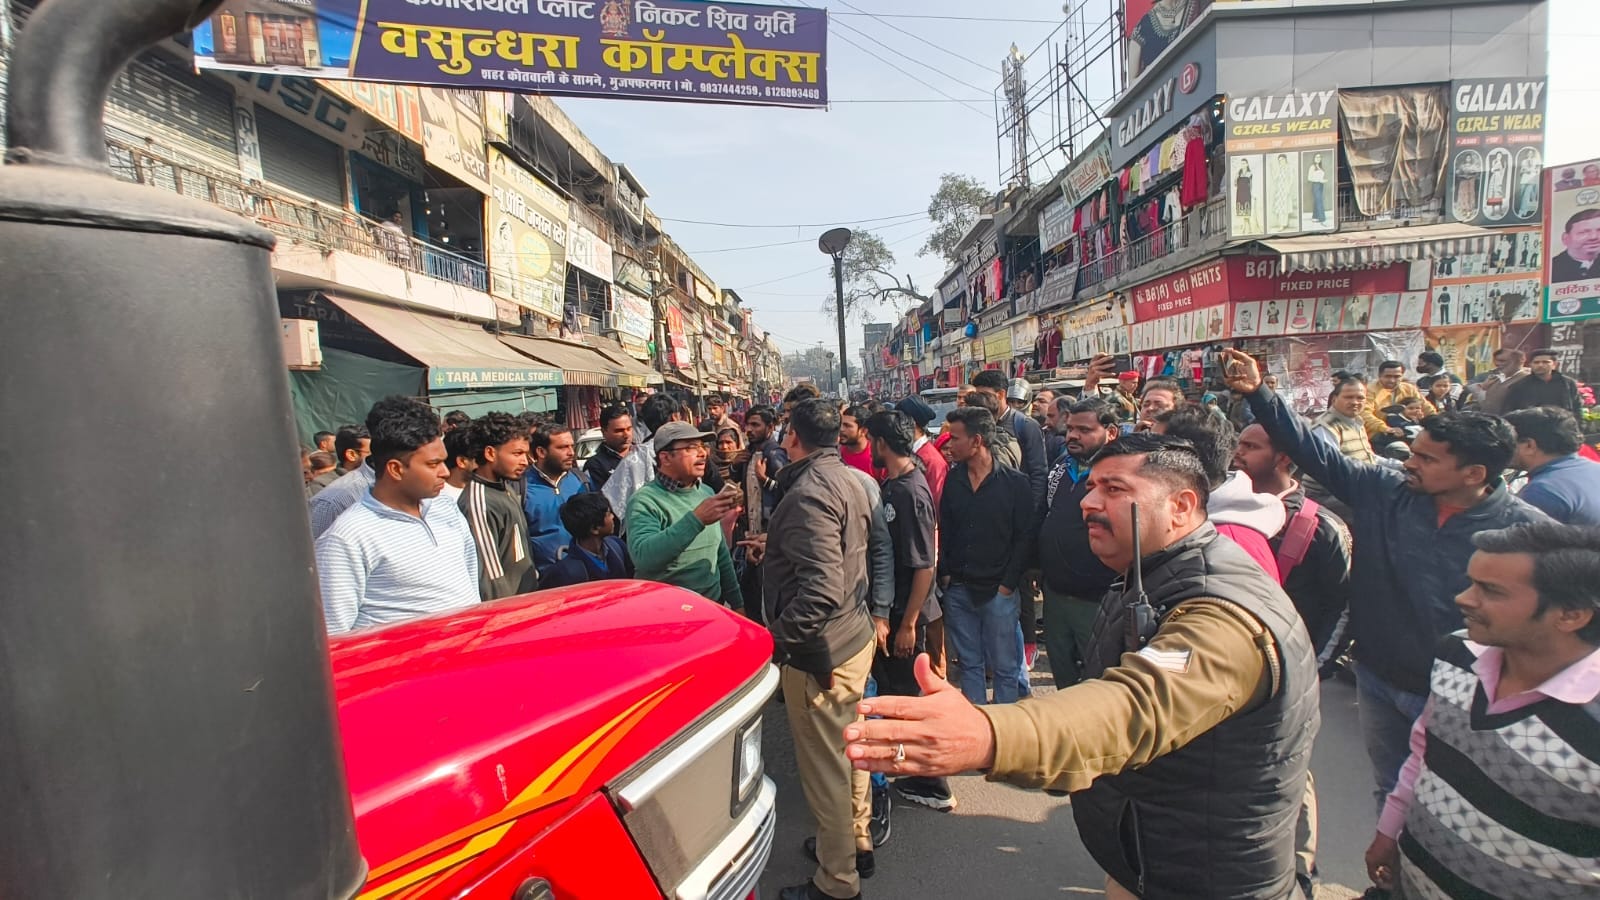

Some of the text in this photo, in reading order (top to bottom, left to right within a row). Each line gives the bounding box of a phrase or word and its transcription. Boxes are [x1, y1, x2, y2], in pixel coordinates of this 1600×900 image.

[634, 0, 701, 28] निकट
[706, 5, 748, 31] शिव
[754, 10, 796, 38] मूर्ति
[377, 21, 821, 84] वसुन्धरा कॉम्प्लेक्स
[481, 69, 504, 81] शहर
[507, 68, 555, 84] कोतवाली
[559, 71, 570, 84] के
[1230, 89, 1335, 122] GALAXY
[1456, 81, 1544, 113] GALAXY
[1118, 77, 1175, 148] GALAXY
[1232, 118, 1333, 136] GIRLS WEAR
[1456, 113, 1543, 133] GIRLS WEAR
[1145, 282, 1170, 304] BAJAJ
[1280, 278, 1351, 292] FIXED PRICE
[1175, 296, 1193, 309] PRICE
[294, 303, 340, 323] TARA
[446, 371, 554, 383] TARA MEDICAL STORE
